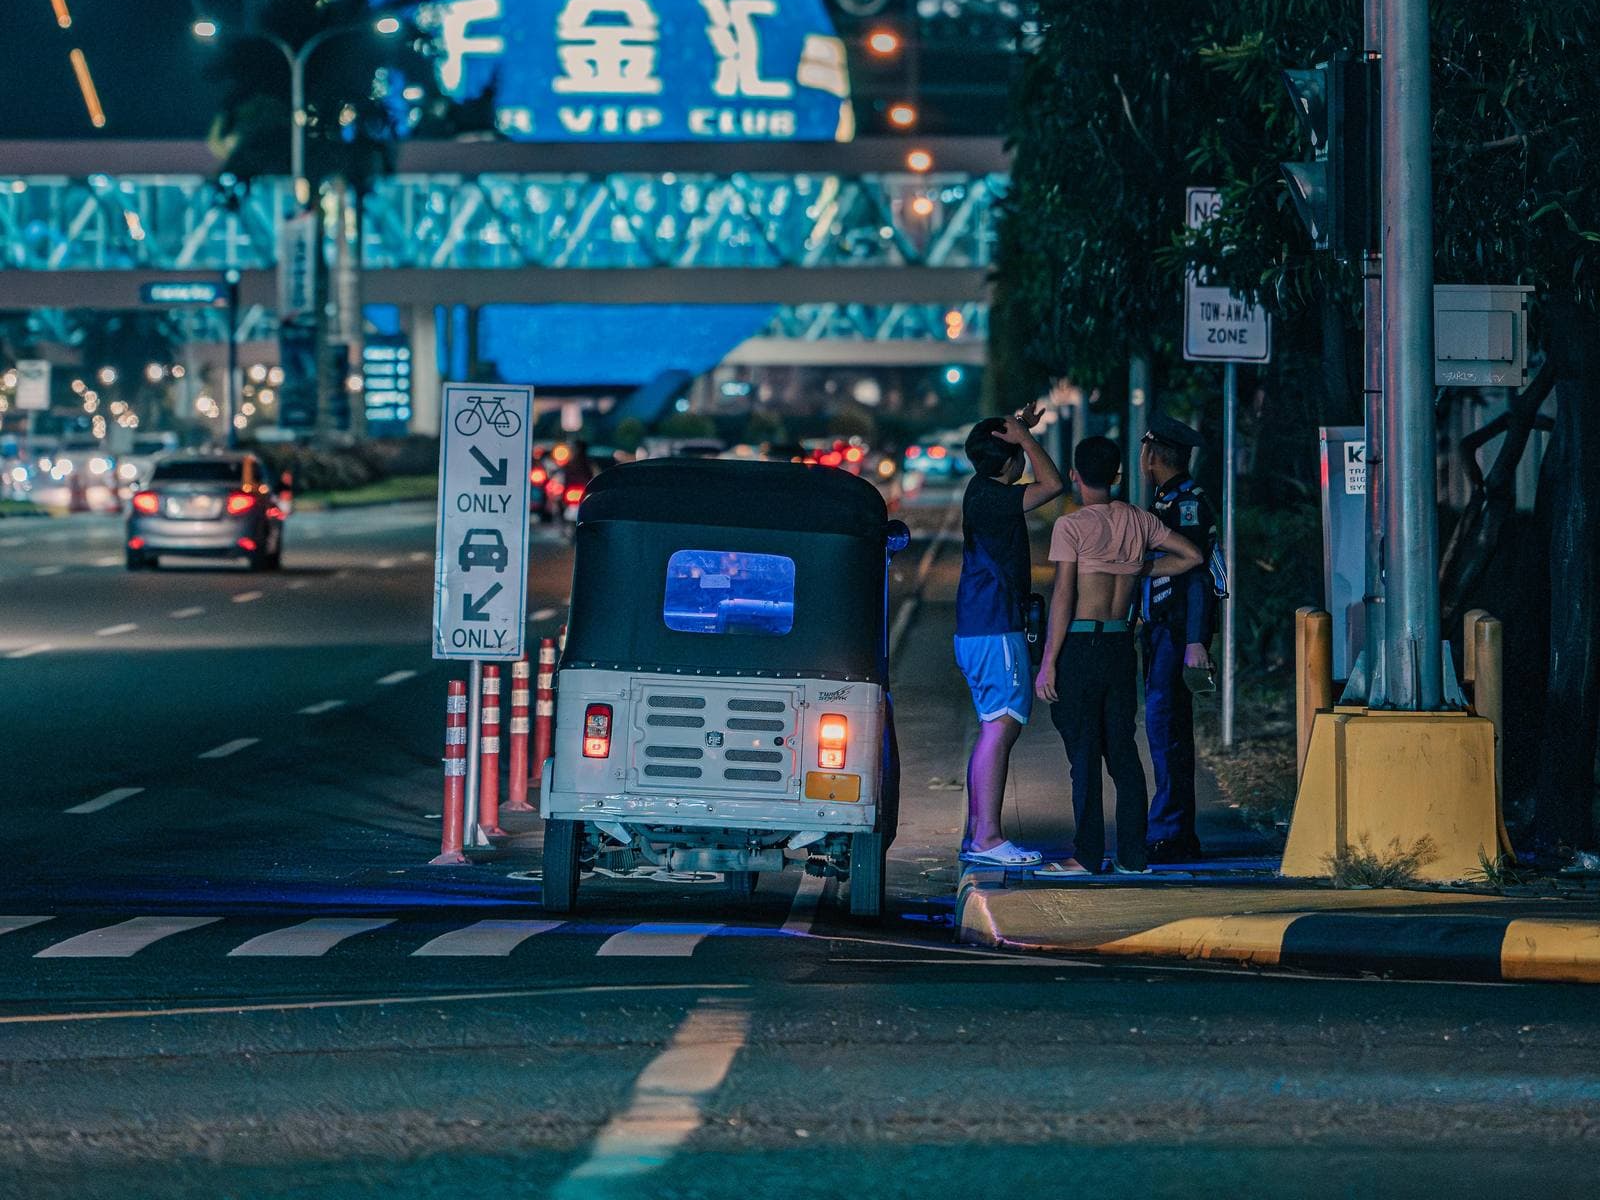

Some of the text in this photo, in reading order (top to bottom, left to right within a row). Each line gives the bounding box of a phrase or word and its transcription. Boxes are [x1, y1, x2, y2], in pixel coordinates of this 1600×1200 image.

[558, 105, 663, 133] VIP
[689, 107, 797, 137] CLUB
[1200, 302, 1256, 323] TOW-AWAY
[1207, 328, 1248, 344] ZONE
[457, 493, 512, 514] ONLY
[452, 628, 507, 649] ONLY
